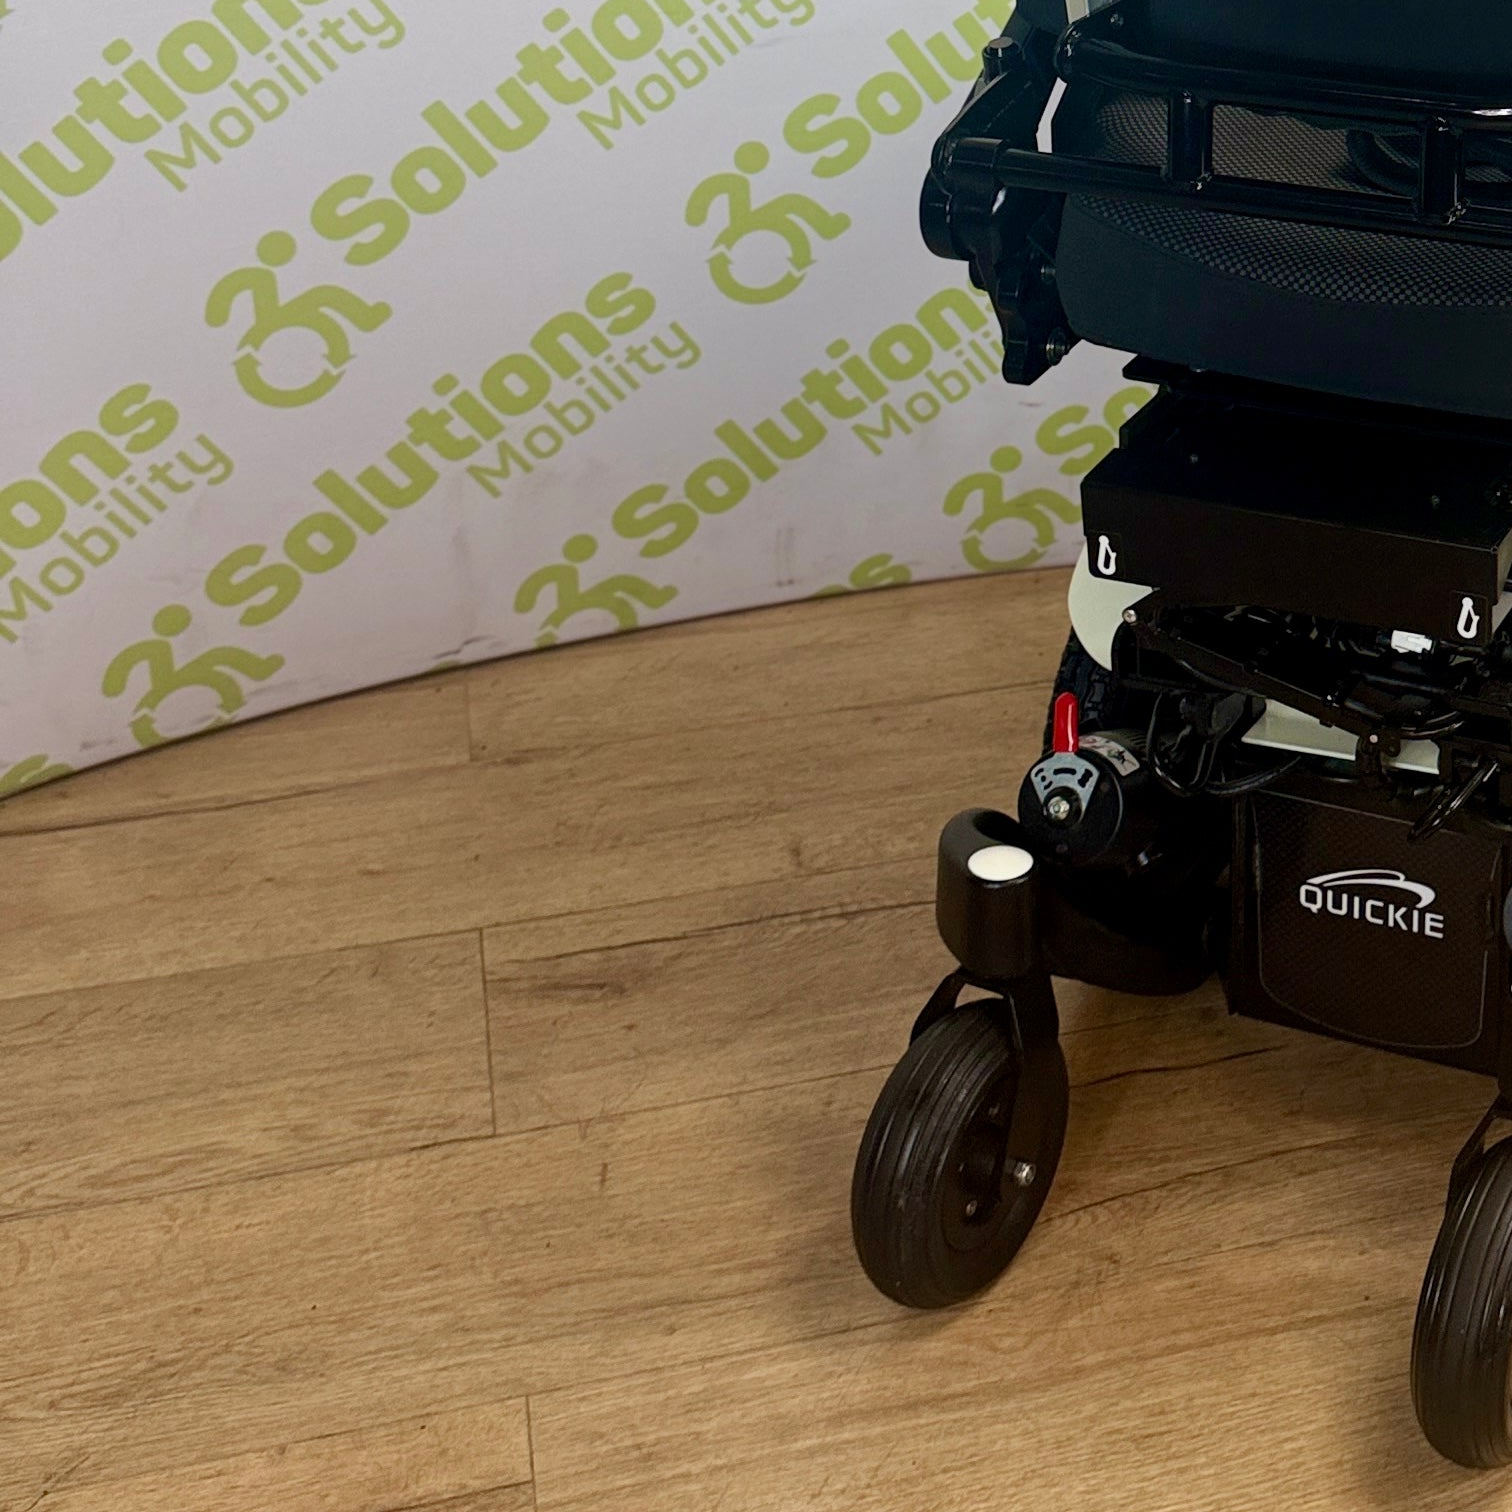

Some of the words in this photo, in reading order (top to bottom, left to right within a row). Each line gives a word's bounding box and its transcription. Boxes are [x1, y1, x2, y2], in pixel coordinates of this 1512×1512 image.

[205, 271, 656, 627] Solutions
[466, 321, 702, 499] Mobility
[611, 278, 995, 558] Solution
[0, 433, 234, 644] Mobility
[1300, 884, 1444, 939] QUICKIE
